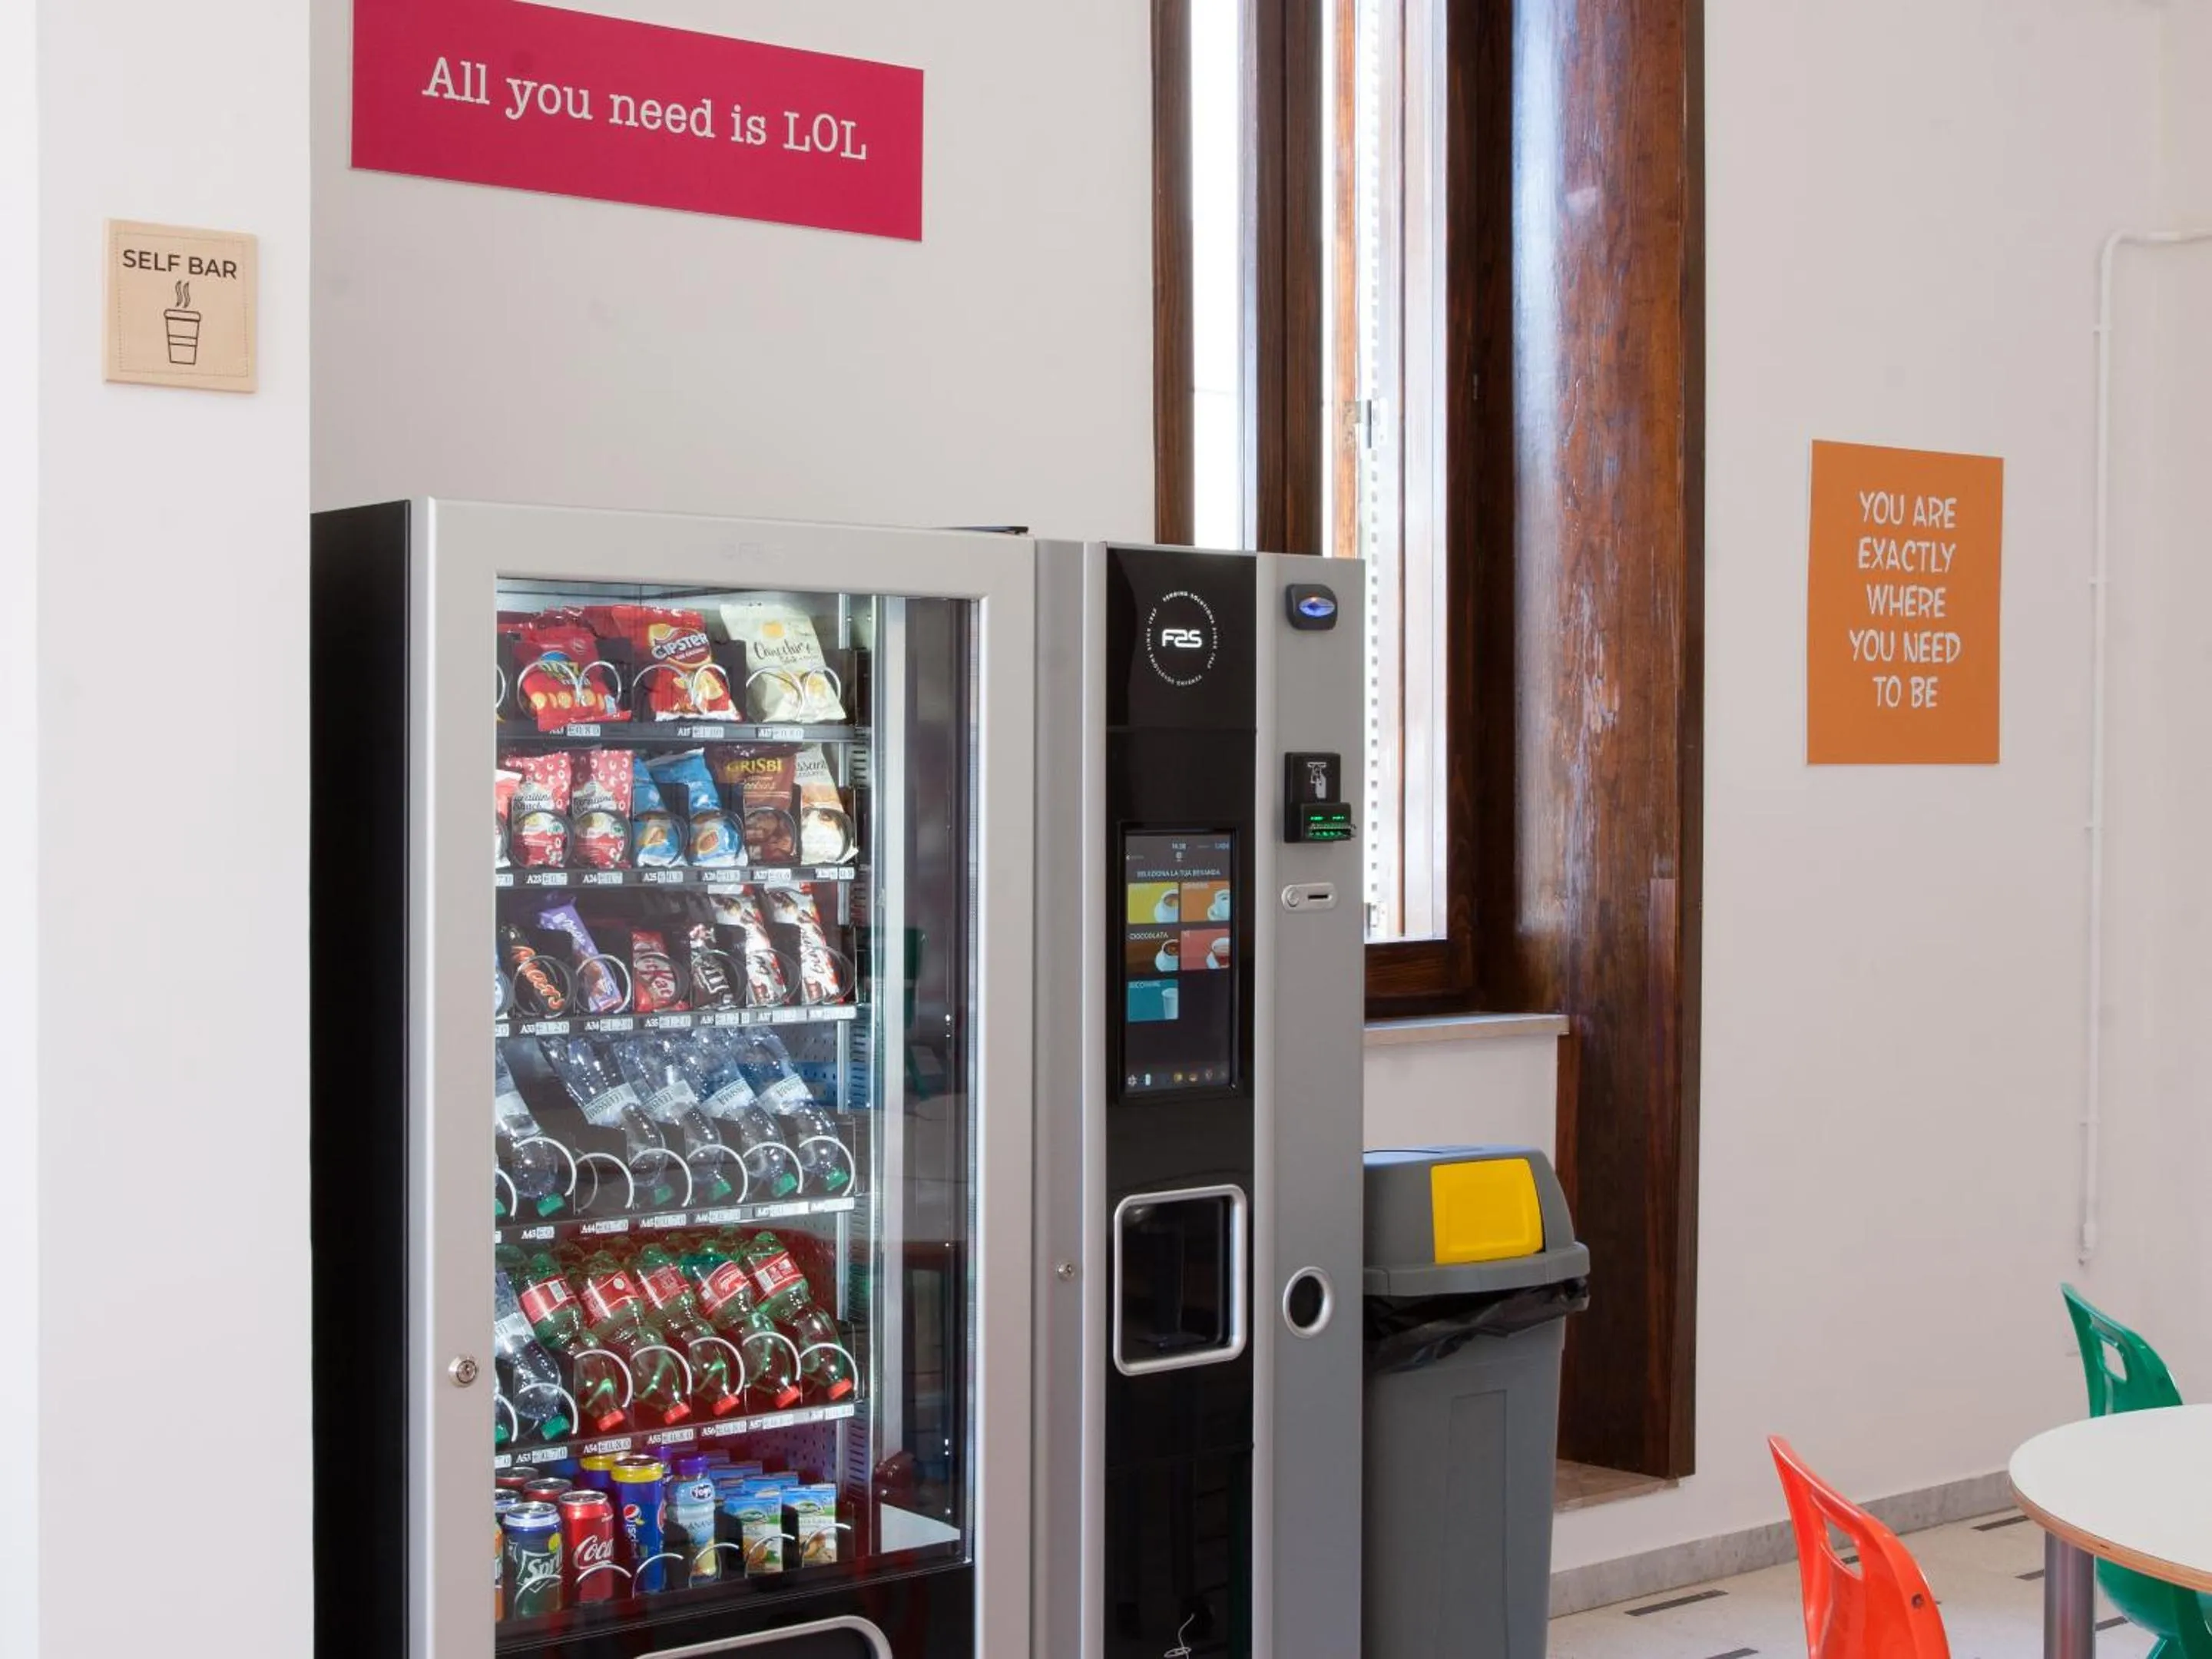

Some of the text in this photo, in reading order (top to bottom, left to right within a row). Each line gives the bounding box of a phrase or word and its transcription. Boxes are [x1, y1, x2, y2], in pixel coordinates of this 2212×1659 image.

[422, 57, 867, 160] All you need is LOL
[123, 249, 237, 280] SELF BAR
[1859, 491, 1958, 528] YOU ARE
[1858, 536, 1956, 573] EXACTLY
[1866, 583, 1946, 618] WHERE
[1849, 629, 1962, 664] YOU NEED
[1873, 675, 1939, 708] TO BE
[573, 1535, 614, 1571] Coca
